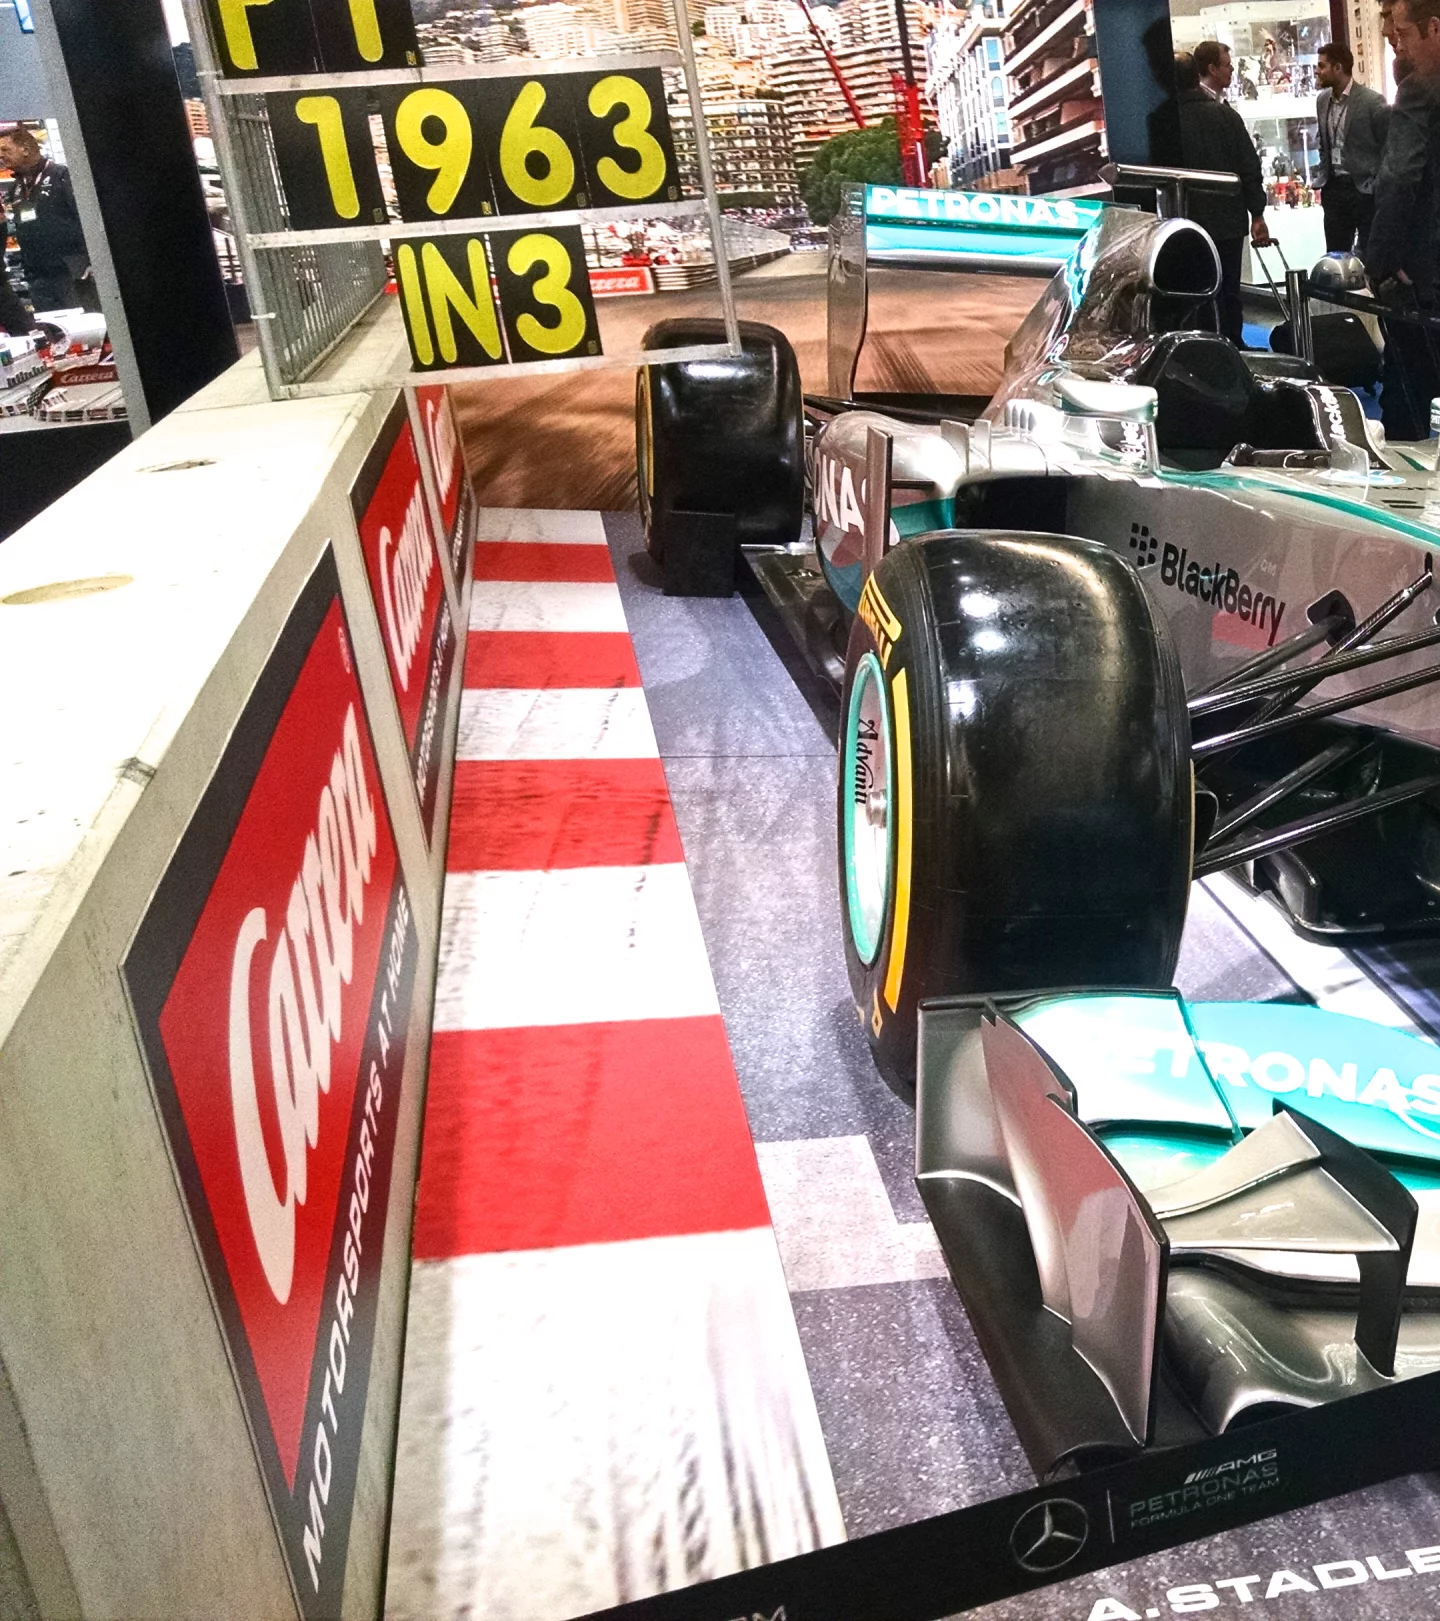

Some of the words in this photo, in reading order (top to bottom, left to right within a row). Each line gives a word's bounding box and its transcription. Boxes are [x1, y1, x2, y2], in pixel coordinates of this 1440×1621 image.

[295, 75, 667, 220] 1963
[871, 187, 1079, 228] PETRONAS
[398, 238, 503, 366] IN
[507, 234, 587, 354] 3
[1160, 541, 1286, 647] BlackBerry
[853, 719, 879, 806] Advanti
[229, 701, 377, 1306] Carrera
[303, 1061, 382, 1594] MOTORSPORTS
[377, 990, 393, 1070] AT
[386, 885, 410, 1007] HOME
[1129, 1462, 1279, 1518] PETRONAS
[1130, 1501, 1202, 1529] FORMULA
[1206, 1492, 1236, 1509] ONE
[1241, 1476, 1280, 1493] TEAM
